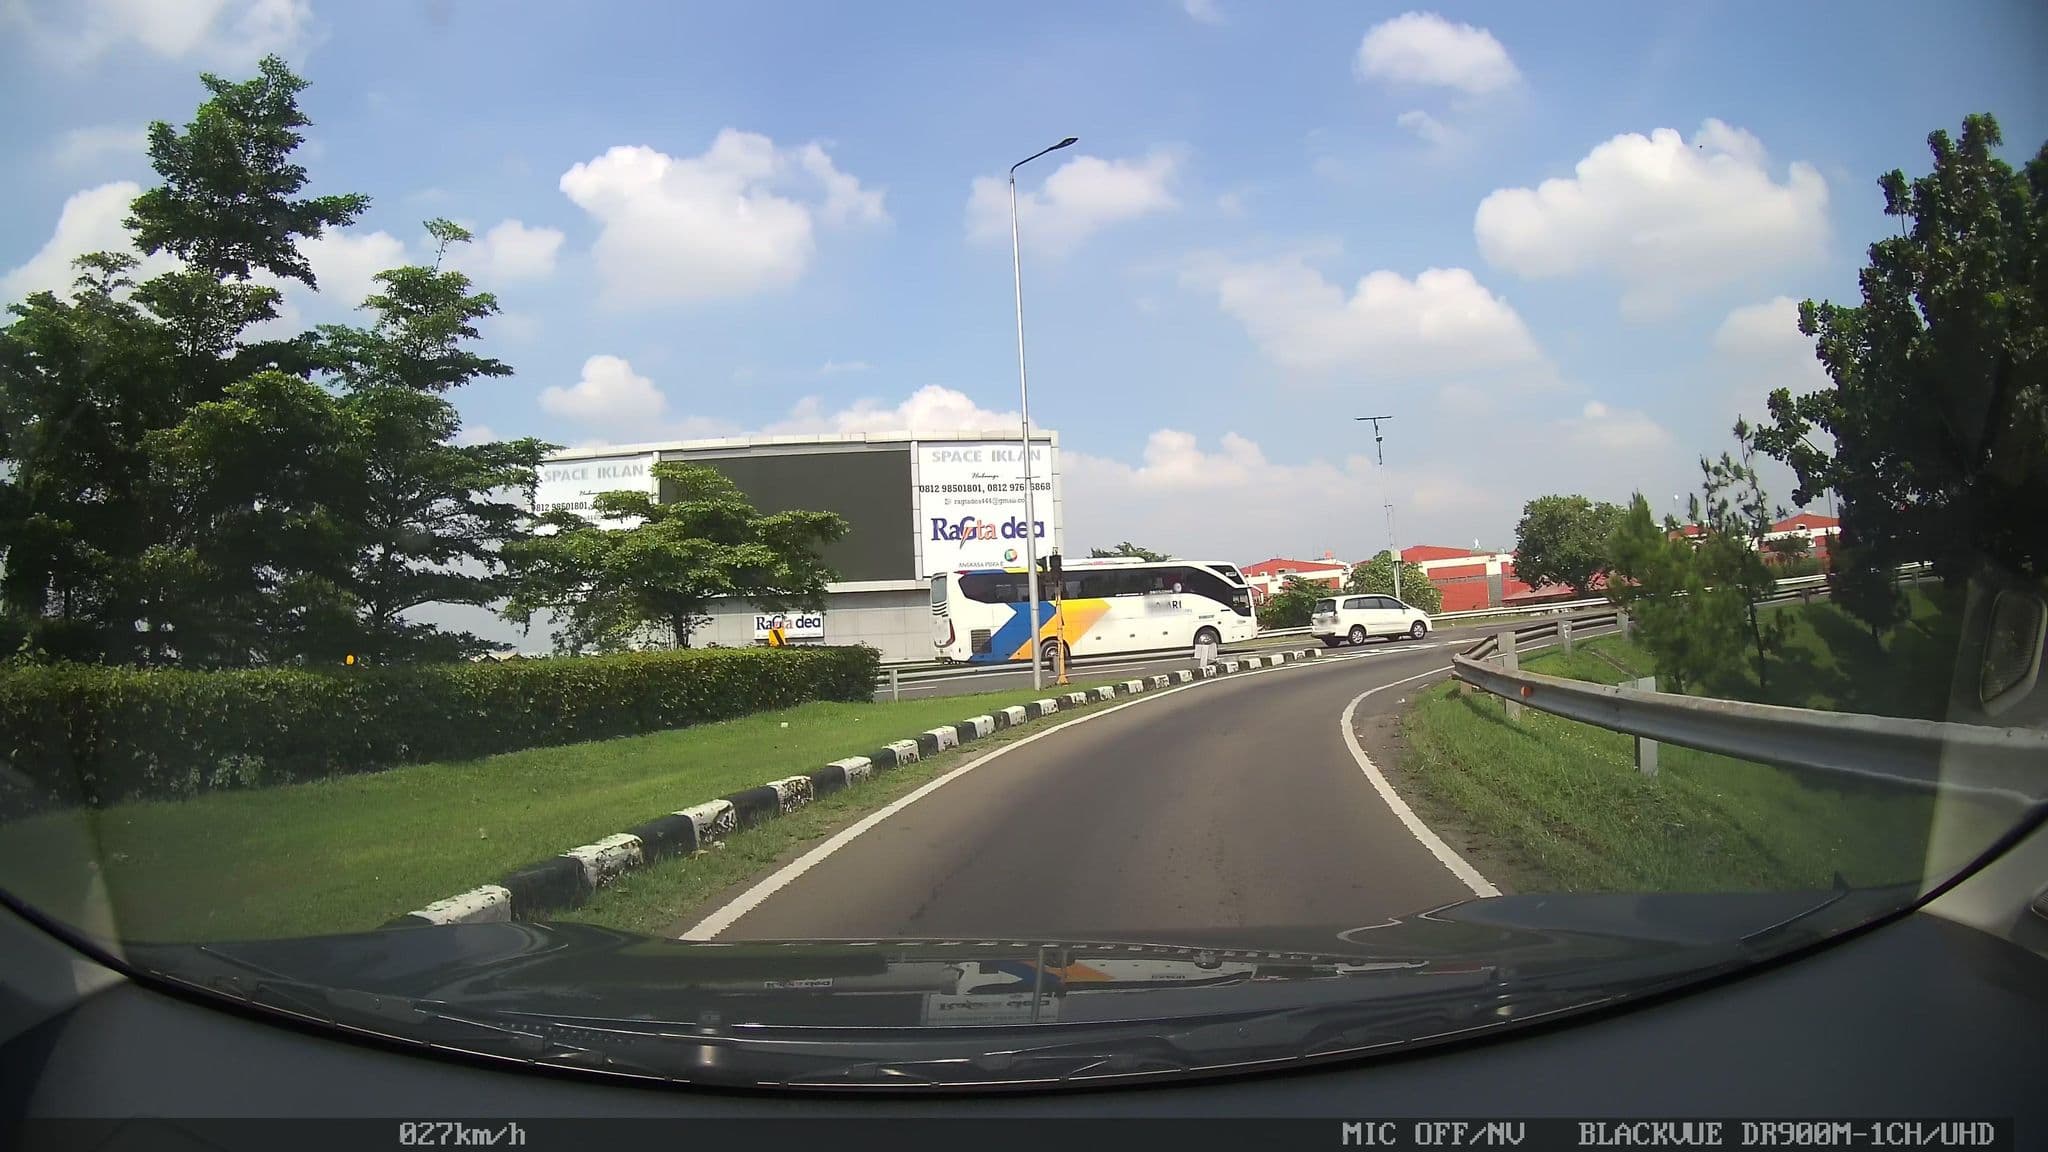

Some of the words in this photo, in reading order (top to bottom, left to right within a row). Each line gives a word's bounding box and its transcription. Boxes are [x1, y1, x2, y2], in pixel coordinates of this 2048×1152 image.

[932, 450, 982, 463] SPACE
[991, 449, 1041, 462] IKLAN
[545, 468, 588, 482] SPACE
[597, 463, 644, 479] IKLAN
[920, 484, 939, 493] 0812
[942, 483, 985, 493] 98501801,
[987, 483, 1007, 492] 0812
[931, 516, 998, 544] RaGta
[1001, 516, 1044, 539] dea
[796, 615, 821, 628] dea
